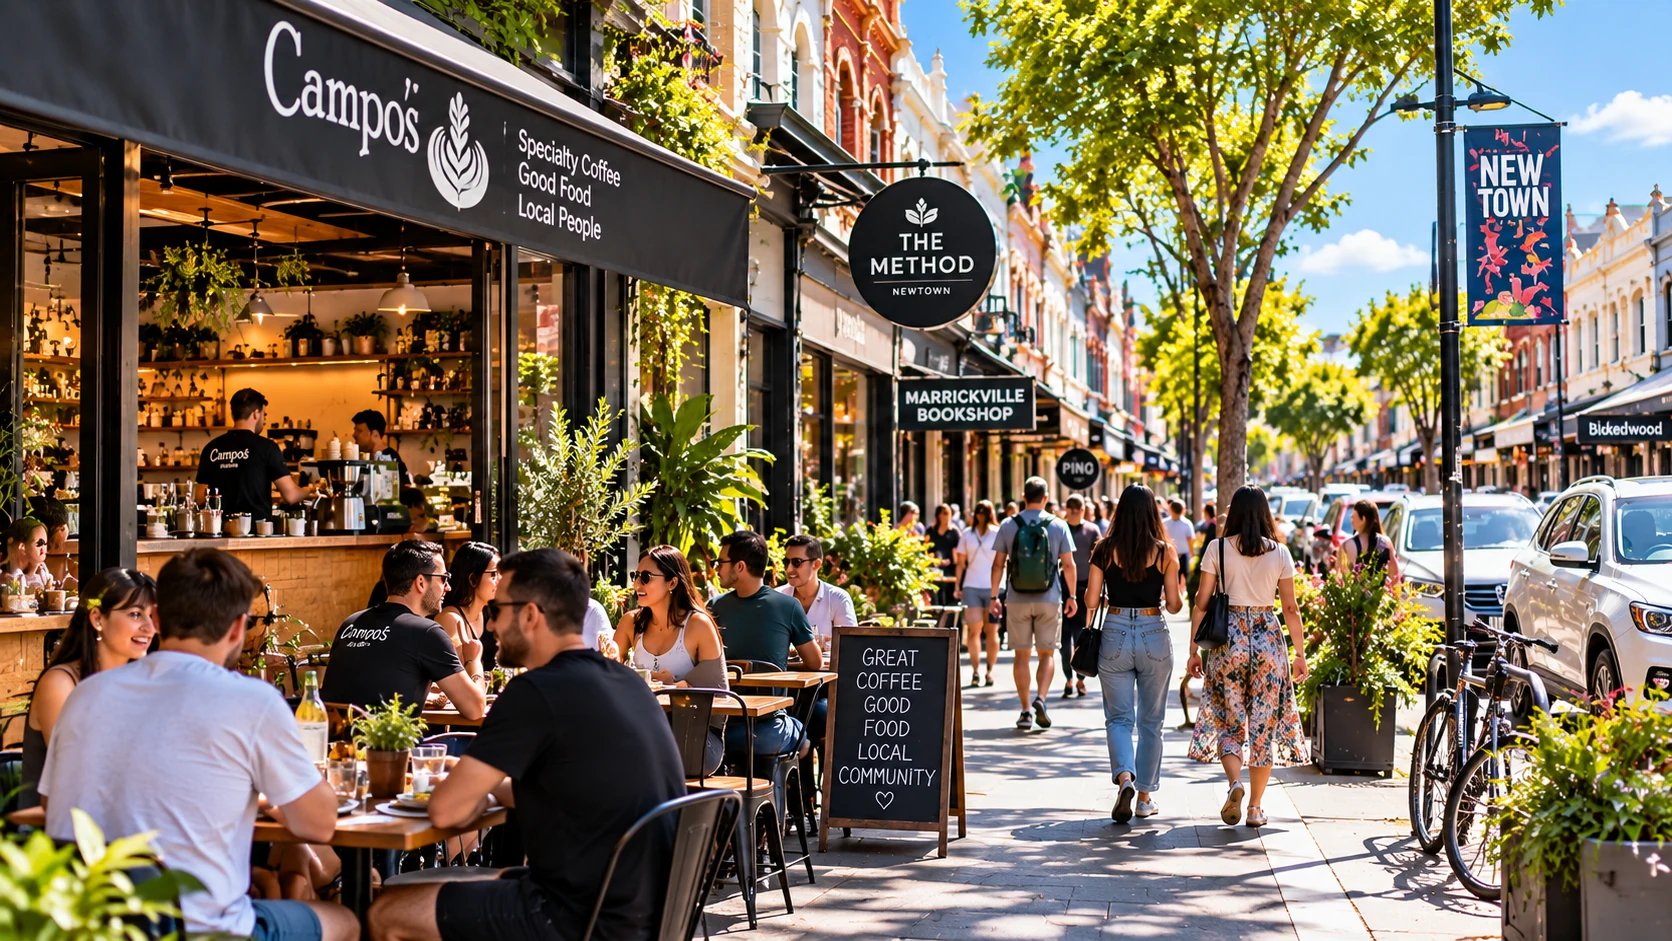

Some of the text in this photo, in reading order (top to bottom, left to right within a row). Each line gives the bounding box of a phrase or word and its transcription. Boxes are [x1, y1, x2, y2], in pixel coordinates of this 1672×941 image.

[518, 128, 621, 188] Specialty Coffee
[1480, 153, 1544, 187] NEW
[518, 161, 592, 206] Good Food
[1477, 188, 1549, 218] TOWN
[518, 194, 602, 242] Local People
[898, 232, 944, 252] THE
[870, 255, 975, 276] METHOD
[892, 286, 951, 296] NEWTOWN
[905, 388, 1025, 405] MARRICKVILLE
[917, 406, 1014, 422] BOOKSHOP
[862, 647, 919, 667] GREAT
[856, 671, 923, 691] COFFEE
[864, 695, 911, 714] GOOD
[864, 719, 910, 737] FOOD
[858, 742, 913, 762] LOCAL
